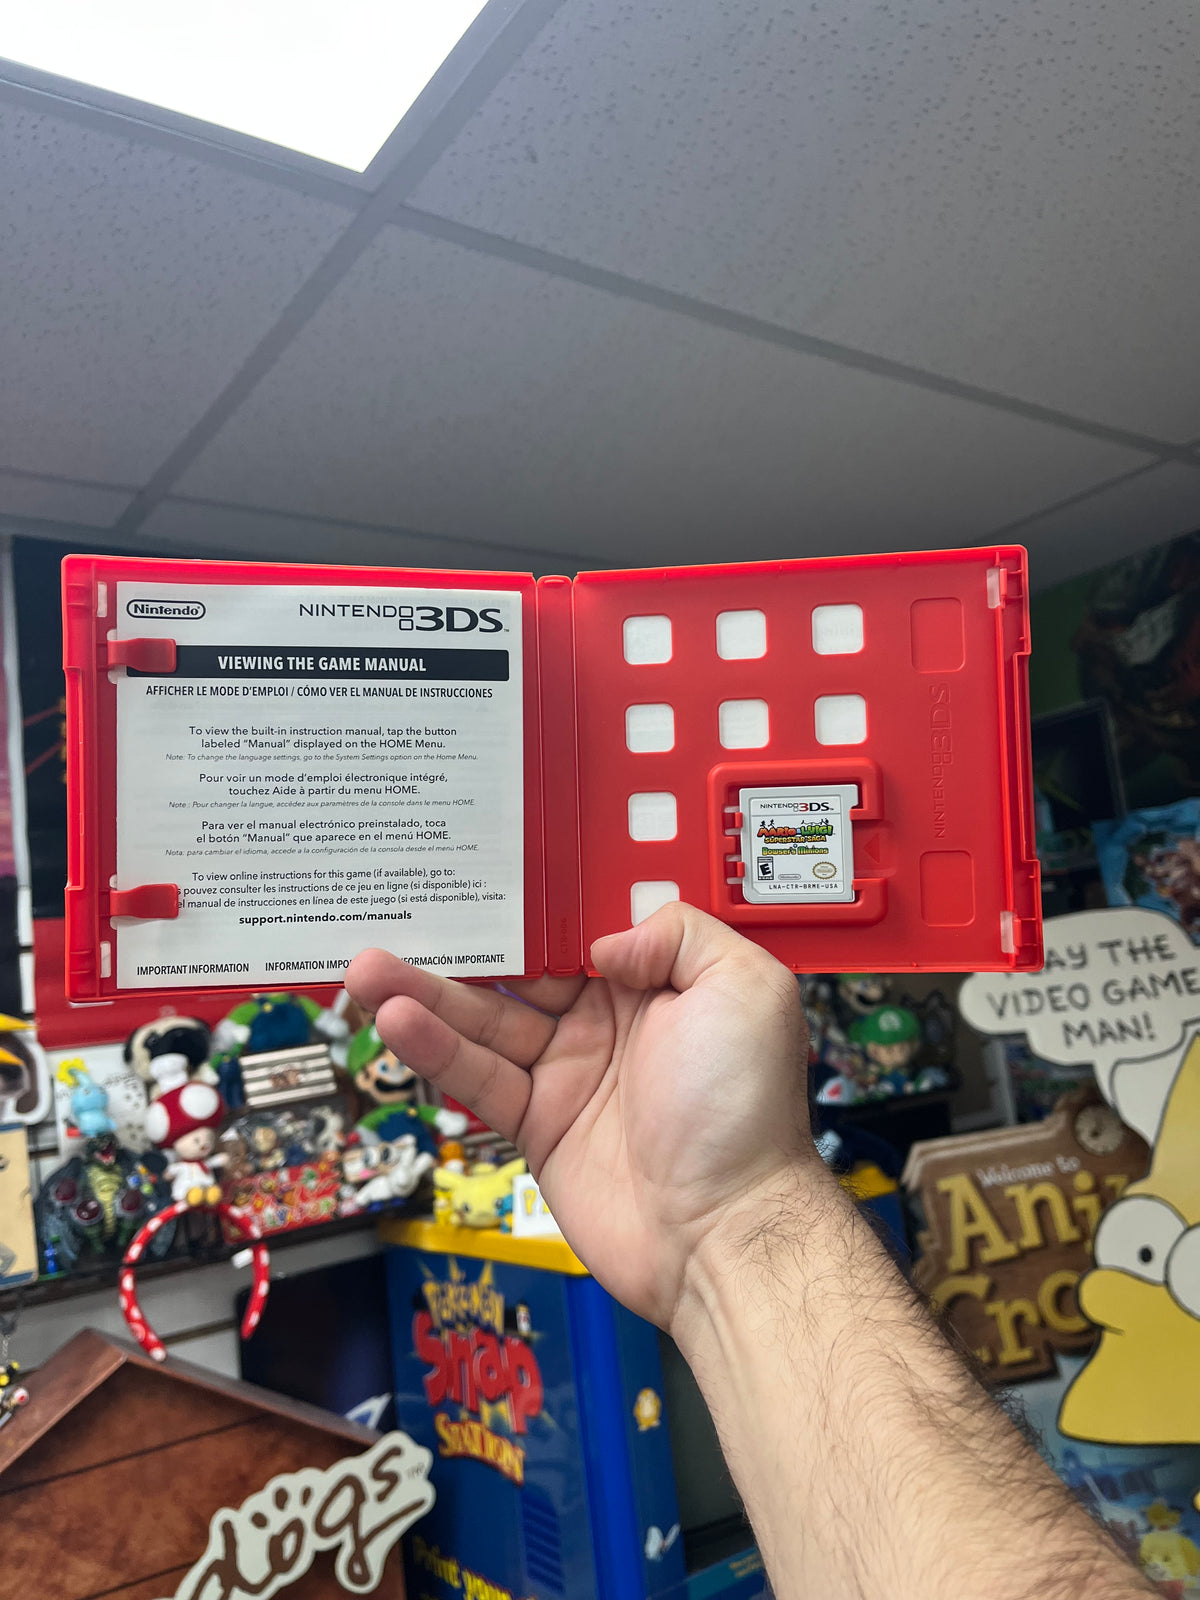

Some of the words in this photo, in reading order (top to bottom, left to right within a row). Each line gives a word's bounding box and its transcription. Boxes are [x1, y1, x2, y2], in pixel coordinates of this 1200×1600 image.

[133, 602, 200, 617] Nintendo
[218, 656, 283, 670] VIEWING
[287, 657, 314, 670] THE
[319, 657, 360, 671] GAME
[365, 657, 426, 671] MANUAL
[146, 685, 194, 696] AFFICHER
[196, 686, 207, 696] LE
[210, 686, 239, 696] MODE
[297, 684, 327, 697] CÓMO
[329, 687, 348, 697] VER
[350, 687, 360, 697] EL
[362, 687, 403, 697] MANUAL
[405, 688, 417, 697] DE
[420, 687, 493, 698] INSTRUCCIONES
[189, 726, 203, 735] To
[205, 726, 229, 735] view
[231, 726, 249, 736] the
[251, 726, 287, 735] built-in
[289, 727, 342, 736] instruction
[345, 726, 385, 737] manual,
[387, 728, 404, 738] tap
[406, 726, 422, 736] the
[424, 726, 457, 736] button
[201, 739, 241, 748] labeled
[293, 739, 342, 750] displayed
[360, 739, 377, 748] the
[379, 739, 412, 748] HOME
[415, 739, 446, 748] Menu.
[197, 754, 224, 762] change
[238, 754, 272, 762] language
[335, 753, 360, 762] System
[361, 753, 389, 762] Settings
[199, 773, 223, 783] Pour
[226, 773, 246, 782] voir
[265, 773, 295, 782] mode
[345, 773, 408, 784] électronique
[410, 773, 448, 784] intégré,
[229, 786, 270, 795] touchez
[272, 786, 296, 795] Aide
[299, 786, 305, 795] à
[308, 786, 335, 797] partir
[338, 785, 351, 795] du
[385, 785, 420, 794] HOME.
[210, 801, 240, 810] changer
[202, 821, 225, 830] Para
[246, 820, 256, 830] el
[259, 820, 297, 829] manual
[299, 820, 356, 829] electrónico
[358, 818, 422, 830] preinstalado,
[196, 834, 206, 843] el
[209, 833, 240, 843] botón
[293, 835, 313, 844] que
[315, 834, 356, 844] aparece
[374, 831, 383, 841] el
[385, 831, 413, 840] menú
[416, 830, 451, 840] HOME.
[271, 847, 296, 855] accede
[192, 872, 204, 881] To
[206, 872, 228, 881] view
[230, 871, 258, 881] online
[260, 870, 312, 880] instructions
[314, 869, 326, 879] for
[328, 869, 344, 878] this
[346, 871, 372, 881] game
[373, 868, 382, 879] (if
[384, 867, 428, 878] available),
[430, 869, 442, 879] go
[183, 887, 217, 897] pouvez
[219, 884, 261, 894] consulter
[263, 884, 276, 893] les
[278, 883, 330, 893] instructions
[331, 882, 343, 892] de
[357, 882, 372, 893] jeu
[387, 881, 409, 893] ligne
[410, 881, 421, 891] (si
[422, 879, 471, 891] disponible)
[472, 879, 482, 888] ici
[187, 898, 222, 908] manual
[223, 898, 236, 907] de
[238, 897, 297, 907] instrucciones
[312, 896, 334, 905] línea
[336, 895, 348, 905] de
[350, 896, 369, 904] este
[370, 895, 396, 906] juego
[398, 894, 408, 904] (si
[410, 893, 428, 903] está
[430, 892, 480, 904] disponible),
[482, 892, 506, 901] visita:
[239, 910, 412, 926] support.nintendo.com/manuals
[1098, 934, 1177, 966] THE
[137, 965, 187, 975] IMPORTANT
[189, 963, 249, 974] INFORMATION
[265, 960, 325, 971] INFORMATION
[326, 957, 352, 969] IMPO
[401, 954, 453, 967] FORMACIÓN
[454, 953, 506, 965] IMPORTANTE
[985, 982, 1091, 1020] VIDEO
[1102, 966, 1200, 1005] GAME
[1062, 1011, 1156, 1048] MAN!
